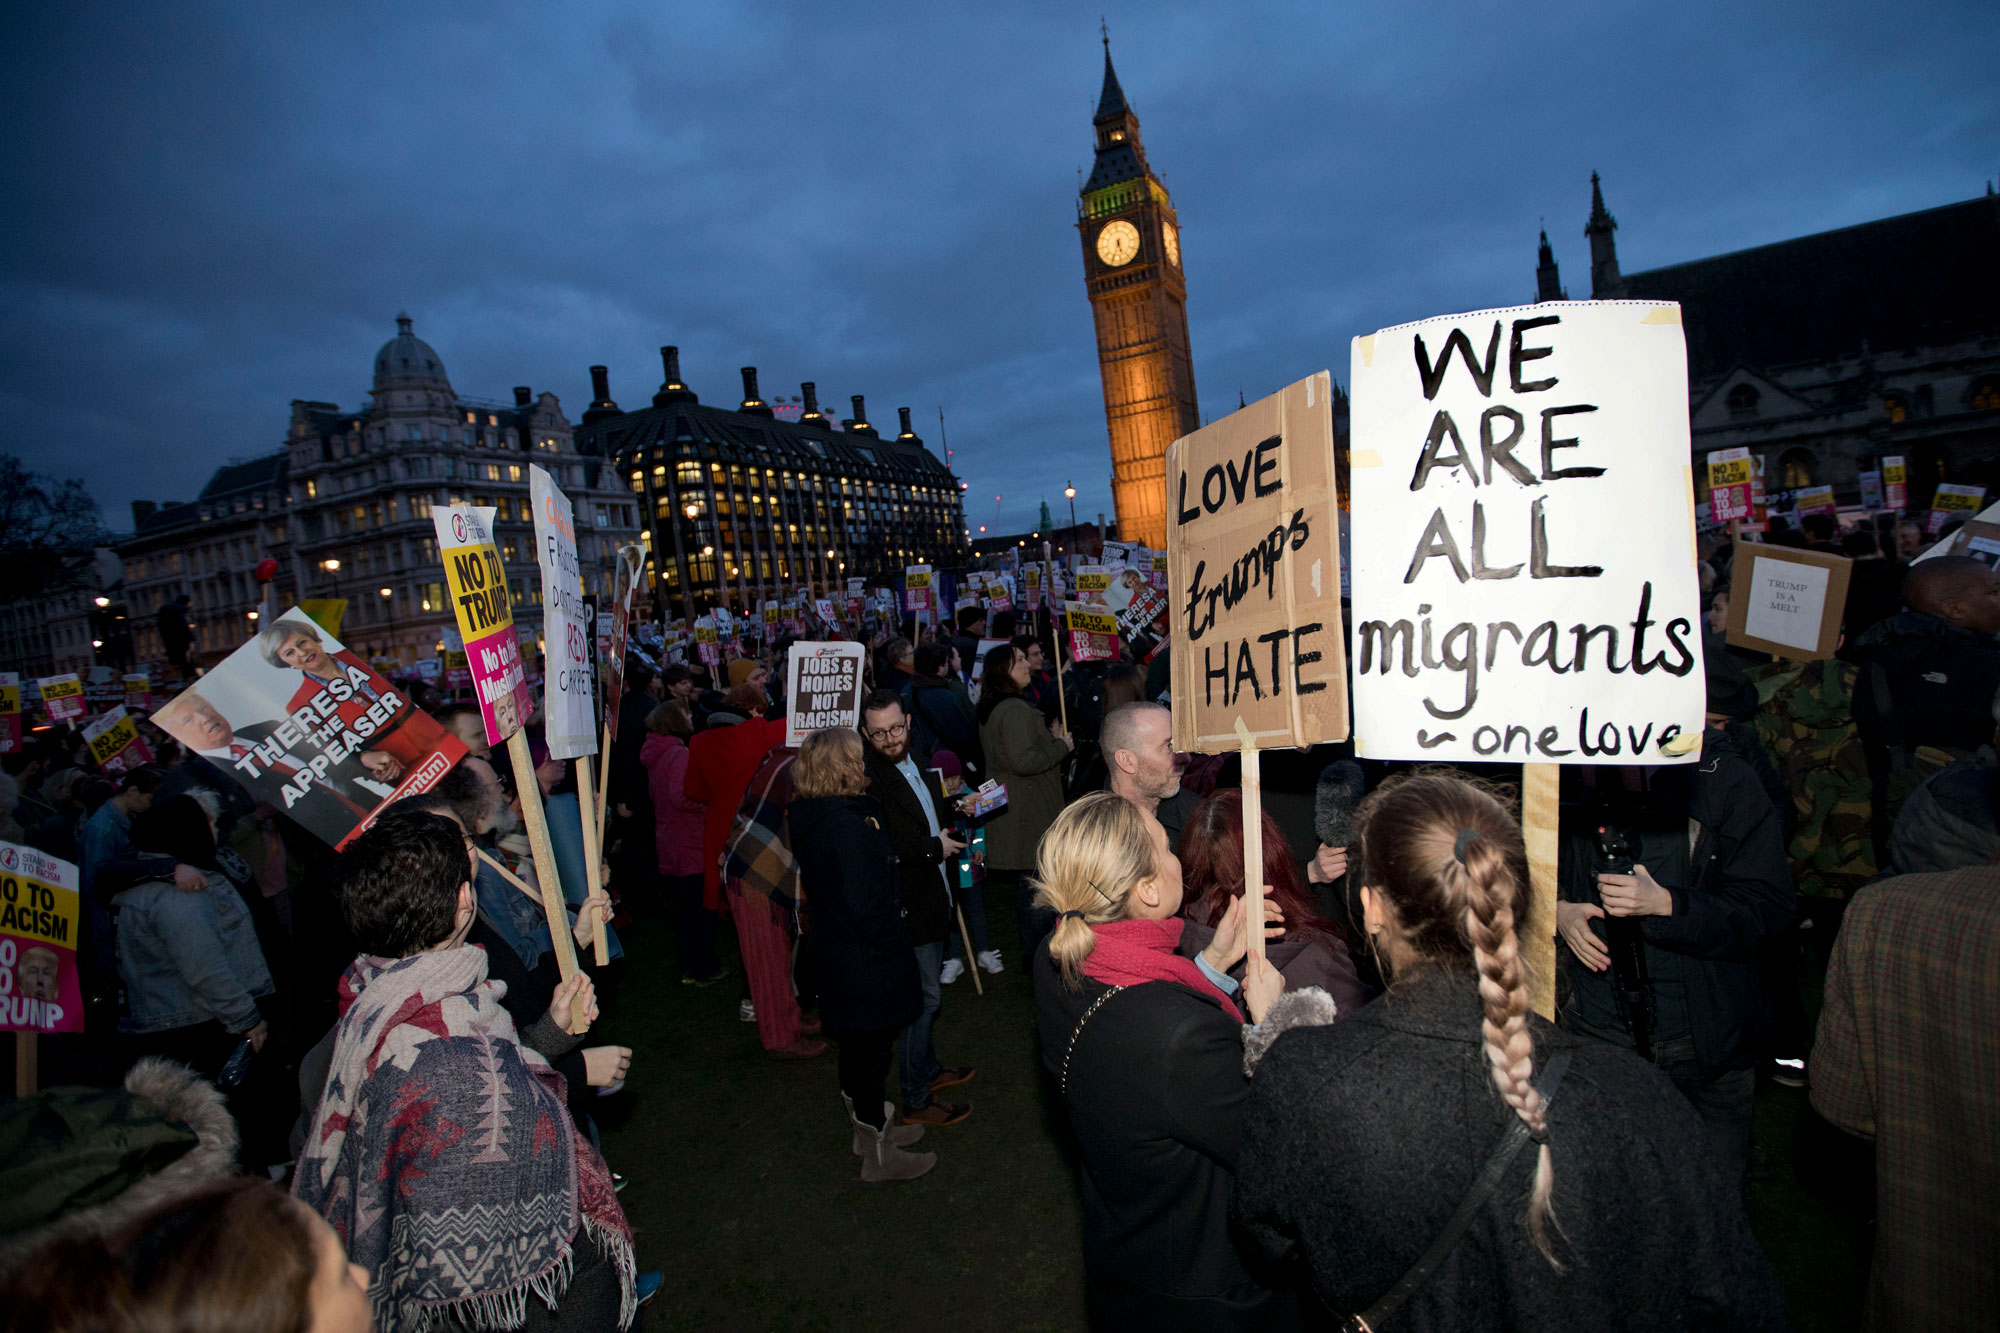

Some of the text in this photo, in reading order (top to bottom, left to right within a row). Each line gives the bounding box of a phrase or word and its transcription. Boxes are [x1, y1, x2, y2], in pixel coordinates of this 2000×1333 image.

[1414, 315, 1560, 400] WE
[1410, 404, 1608, 491] ARE
[1177, 434, 1283, 526] LOVE
[1712, 463, 1740, 475] NO TO
[1713, 472, 1746, 486] RACISM
[1713, 488, 1729, 499] NO
[1715, 499, 1730, 509] TO
[1715, 506, 1748, 519] TRUMP
[1404, 494, 1604, 584] ALL
[453, 549, 501, 593] NO TO
[1091, 574, 1101, 582] TO
[1183, 507, 1310, 641] trumps
[1079, 581, 1106, 590] RACISM
[1767, 578, 1808, 592] TRUMP
[1775, 591, 1796, 602] IS A
[459, 585, 510, 632] TRUMP
[1071, 612, 1102, 624] NO TO
[1134, 608, 1148, 621] THE
[1770, 601, 1800, 614] MELT
[1072, 620, 1112, 632] RACISM
[1126, 598, 1168, 644] APPEASER
[567, 622, 586, 665] RED
[1073, 631, 1089, 639] NO
[1074, 639, 1090, 647] TO
[480, 647, 499, 674] No
[497, 643, 509, 666] to
[506, 637, 517, 660] the
[1076, 647, 1113, 659] TRUMP
[1359, 581, 1695, 720] migrants
[802, 657, 854, 675] JOBS &
[1205, 622, 1327, 708] HATE
[480, 668, 516, 705] Muslim
[801, 674, 853, 693] HOMES
[811, 692, 841, 711] NOT
[234, 665, 371, 779] THERESA
[794, 710, 854, 729] RACISM
[93, 725, 121, 748] NO TO
[306, 714, 346, 749] THE
[1472, 707, 1682, 758] one love
[100, 731, 133, 760] RACISM
[280, 691, 403, 809] APPEASER
[105, 756, 124, 770] NO
[22, 854, 57, 872] STAND UP
[23, 862, 61, 883] TO RACISM
[0, 876, 55, 912] O TO
[0, 903, 68, 942] ACISM
[0, 938, 17, 968] O
[0, 966, 13, 995] O
[0, 997, 64, 1029] RUMP
